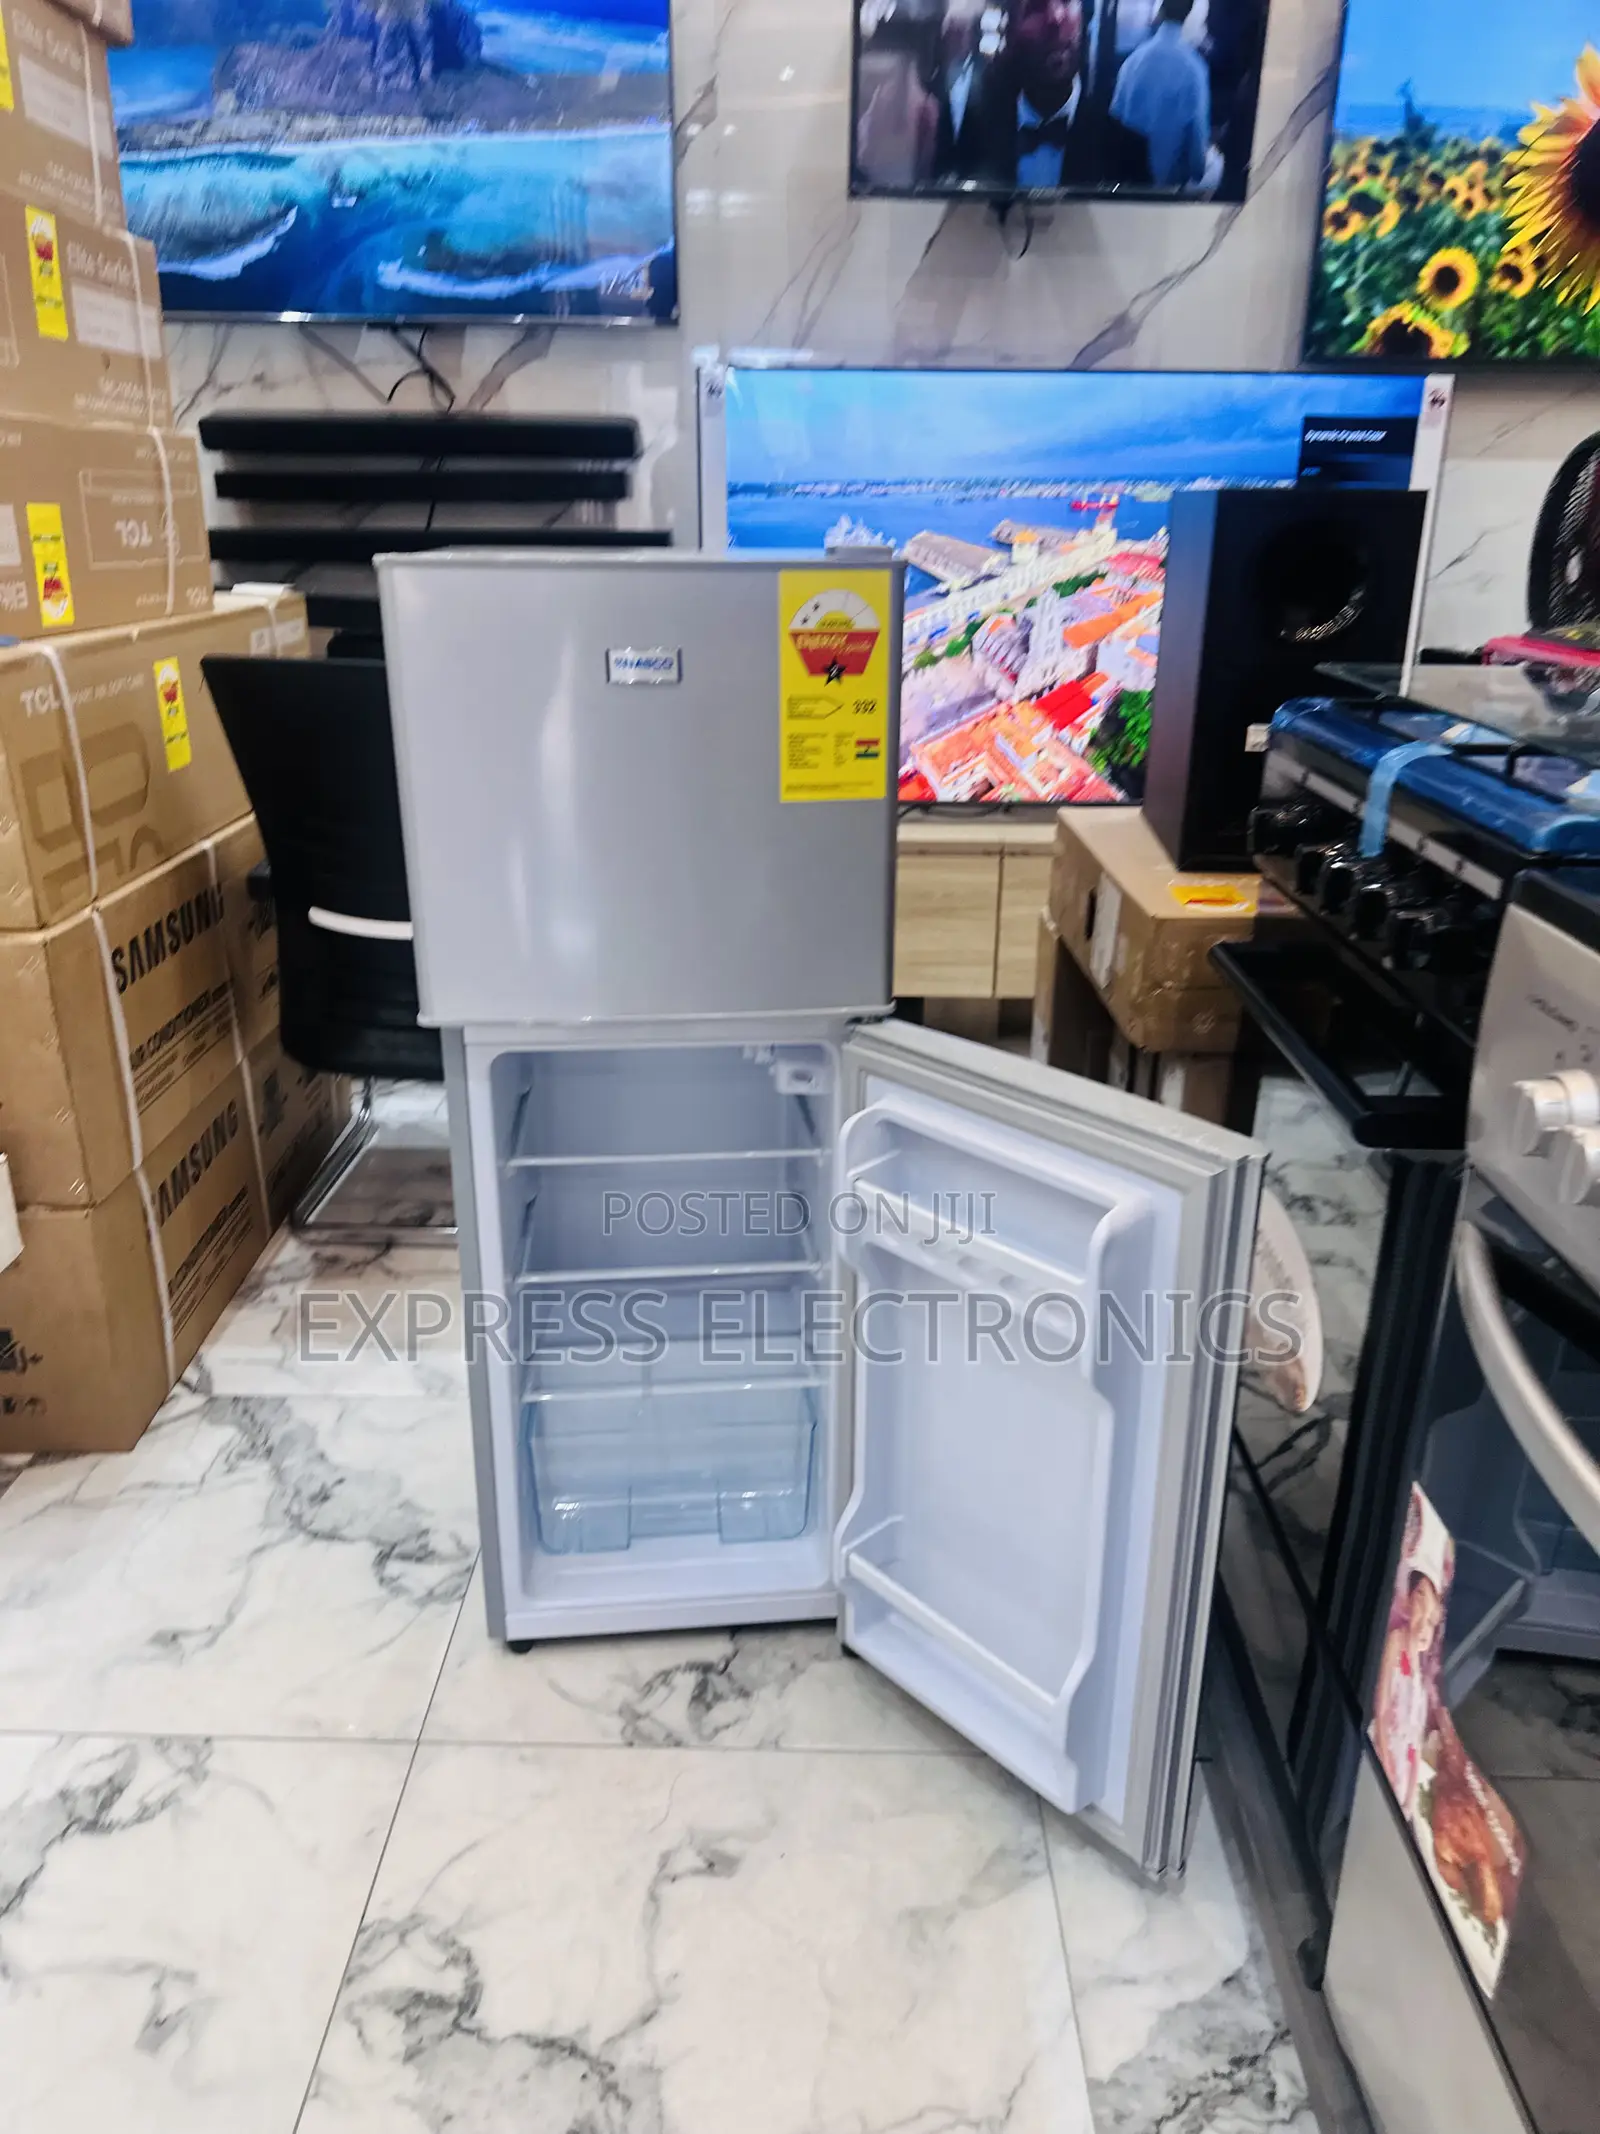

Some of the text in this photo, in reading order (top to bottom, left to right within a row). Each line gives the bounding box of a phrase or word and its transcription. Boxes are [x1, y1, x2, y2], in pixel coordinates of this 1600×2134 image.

[114, 518, 154, 549] TCL
[20, 683, 60, 718] TCL
[111, 882, 224, 996] SAMSUNG
[152, 1098, 238, 1228] AMSUNG
